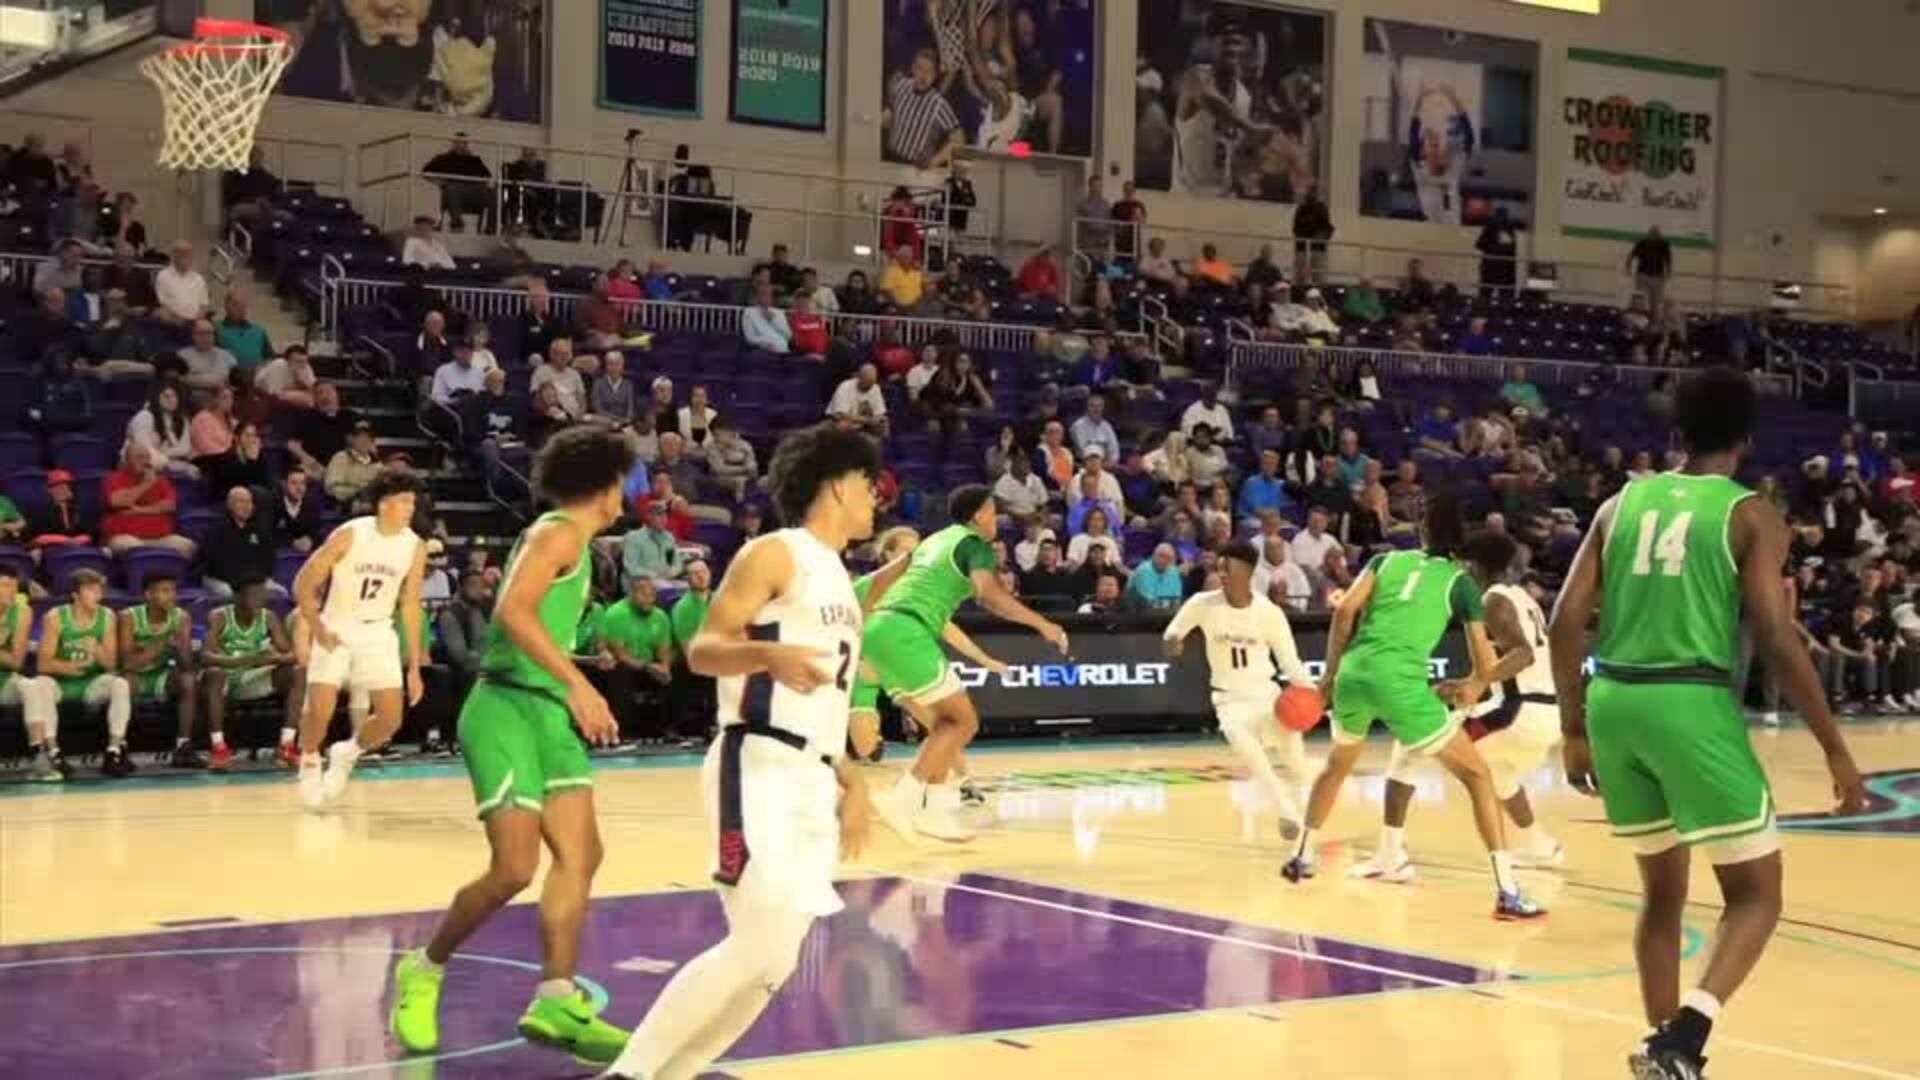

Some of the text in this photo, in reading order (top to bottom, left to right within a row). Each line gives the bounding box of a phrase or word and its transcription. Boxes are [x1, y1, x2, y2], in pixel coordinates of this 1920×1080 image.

[1563, 96, 1712, 144] CROWTHER
[1574, 134, 1696, 176] ROOFING
[1631, 510, 1694, 577] 14
[1399, 570, 1422, 601] 1
[835, 639, 852, 693] 2
[1001, 663, 1170, 688] CHEVROLET
[1231, 646, 1249, 670] 11
